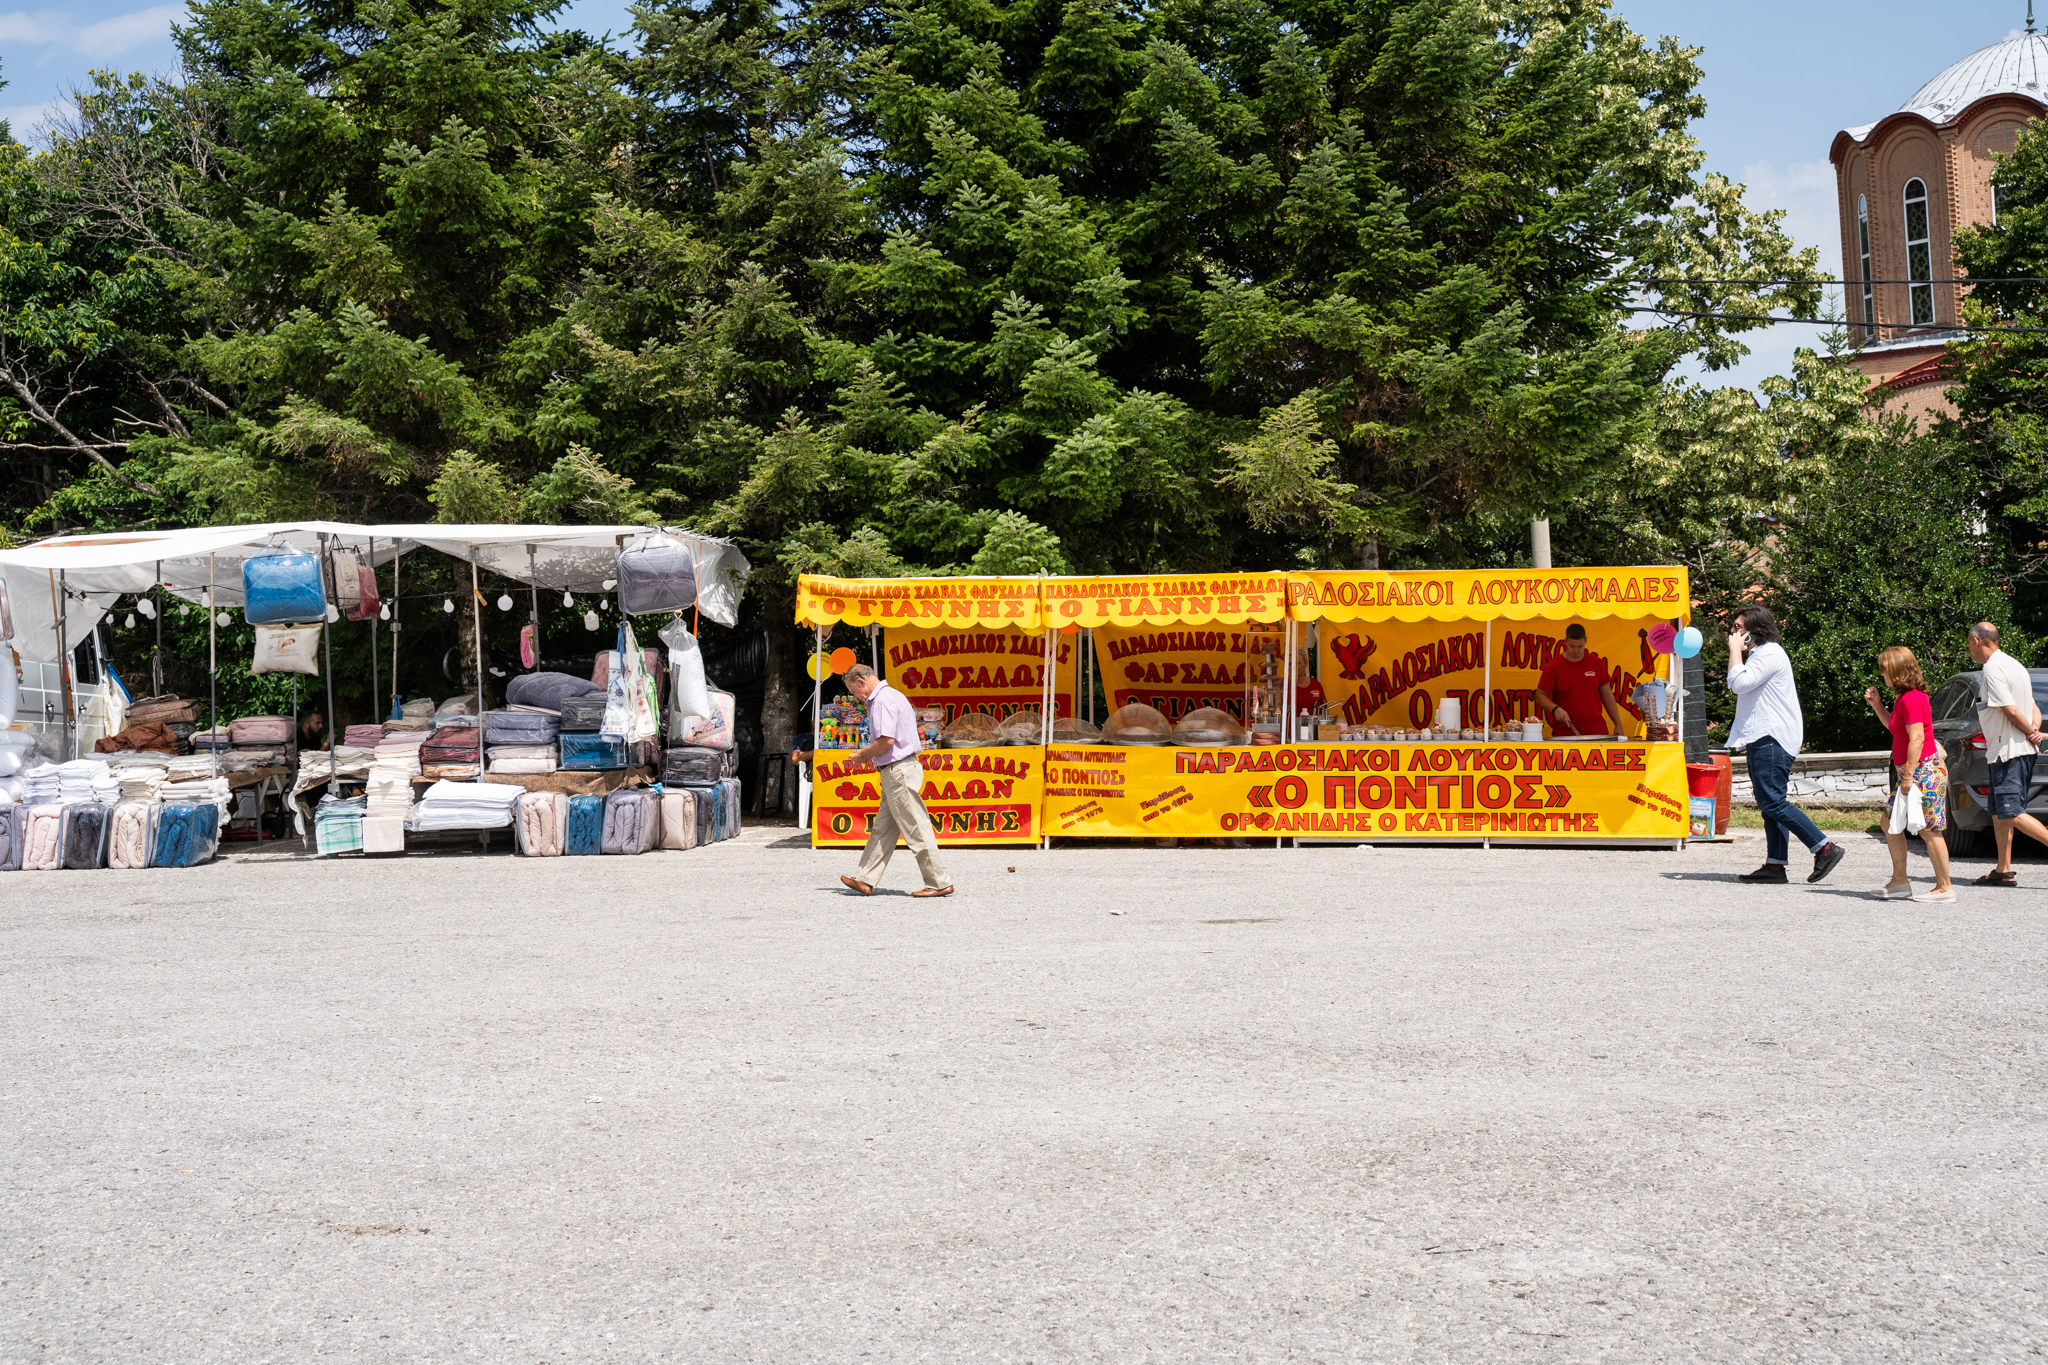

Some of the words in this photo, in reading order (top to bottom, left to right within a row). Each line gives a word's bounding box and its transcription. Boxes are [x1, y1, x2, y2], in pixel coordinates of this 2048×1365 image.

[809, 581, 911, 599] ΠΑΡΑΔΟΣΙΑΚΟΣ
[914, 585, 967, 599] ΧΑΛΒΑΣ
[1045, 582, 1149, 599] ΠΑΡΑΔΟΣΙΑΚΟΣ
[1153, 581, 1206, 596] ΧΑΛΒΑΣ
[1289, 581, 1454, 606] ΡΑΔΟΣΙΑΚΟΙ
[1467, 577, 1680, 605] ΛΟΥΚΟΥΜΑΔΕΣ
[889, 633, 1006, 668] ΠΑΡΑΔΟΣΙΑΚΟΣ
[1009, 635, 1071, 665] ΧΑΛΣ
[1107, 631, 1227, 661] ΠΑΡΑΔΟΣΙΑΚΟΣ
[1342, 632, 1485, 726] ΠΑΡΑΔΟΣΙΑΚΟΙ
[1409, 689, 1433, 730] Ο
[816, 754, 953, 782] ΠΑΡΑΔΚΟΣ
[958, 754, 1030, 780] ΧΑΛΒΑΣ
[1084, 751, 1126, 763] ΛΟΥΚΟΥΜΑΔΕΣ
[1176, 750, 1399, 774] ΠΑΡΑΔΟΣΙΑΚΟΙ
[1408, 748, 1646, 771] ΛΟΥΚΟΥΜΑΔΕΣ
[1062, 768, 1125, 785] ΠΟΝΤΙΟΣ»
[835, 779, 1015, 801] ΦΑΑΛΩΝ
[1077, 788, 1082, 797] Ο
[1139, 785, 1187, 810] Παράδοση
[1247, 775, 1308, 809] «Ο
[1324, 774, 1573, 809] ΠΟΝΤΙΟΣ»
[1635, 783, 1683, 812] Παράδοση
[1085, 806, 1104, 819] 1970
[1160, 805, 1171, 814] το
[1171, 792, 1194, 808] 1970
[830, 812, 853, 835] Ο
[1220, 812, 1372, 831] ΟΡΦΑΝΙΔΗΣ
[1378, 812, 1397, 831] Ο
[1405, 811, 1599, 831] ΚΑΤΕΡΙΝΙΩΤΗΣ
[1660, 807, 1682, 823] 1970
